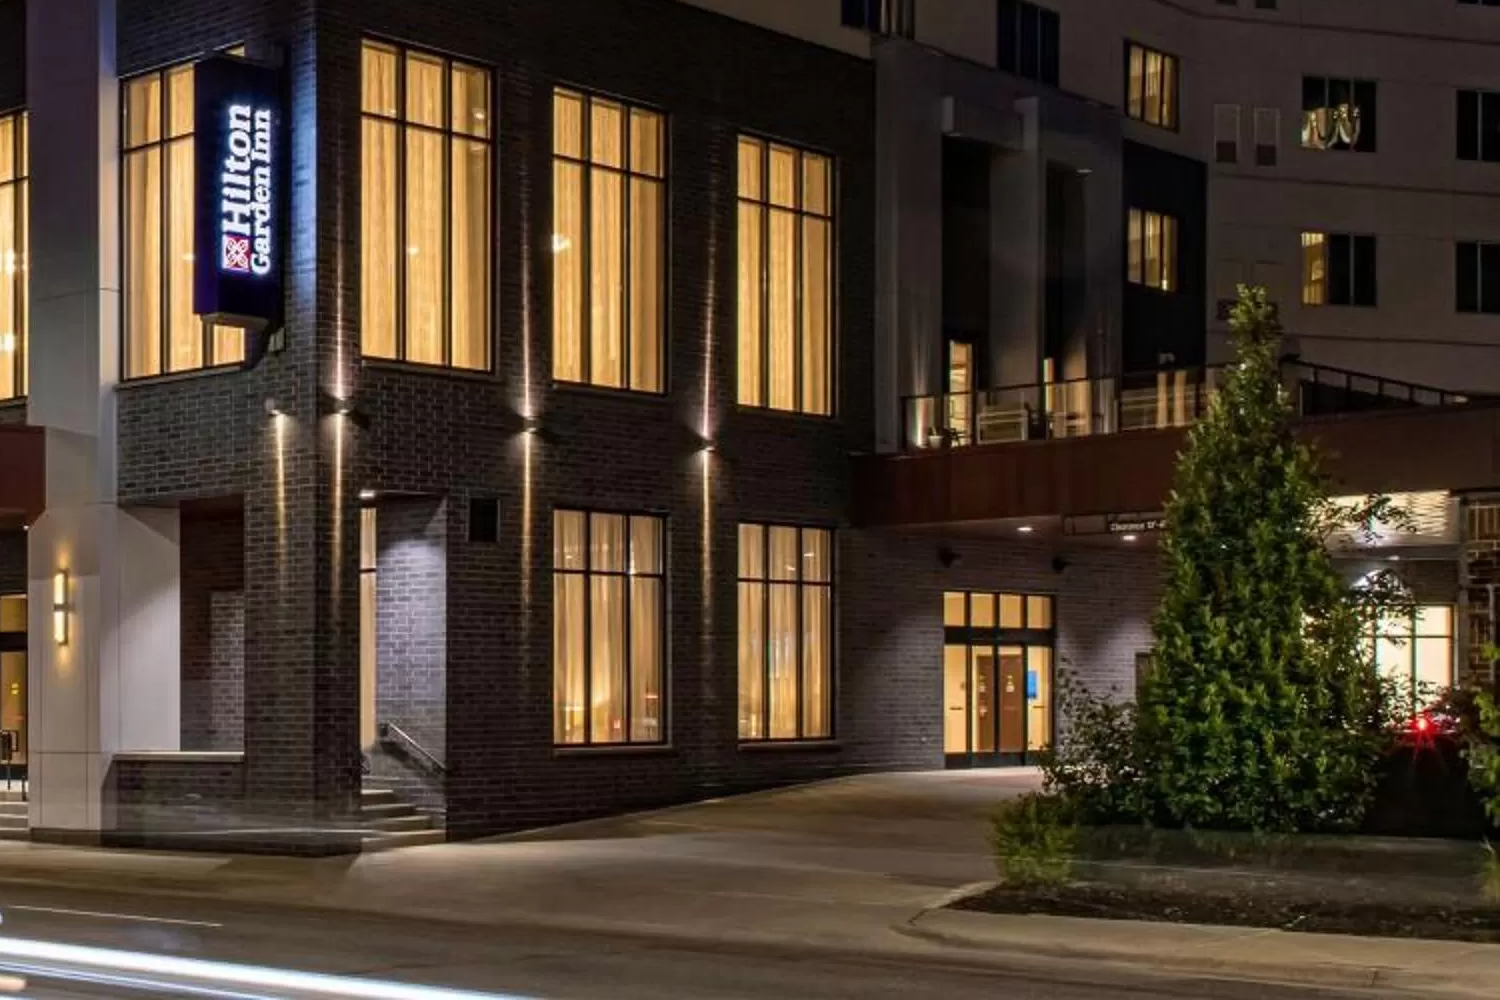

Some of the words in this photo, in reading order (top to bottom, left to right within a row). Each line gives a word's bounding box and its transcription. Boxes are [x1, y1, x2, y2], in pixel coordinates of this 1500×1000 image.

[221, 104, 251, 236] Hilton
[251, 109, 272, 163] Inn
[251, 165, 272, 275] Garden
